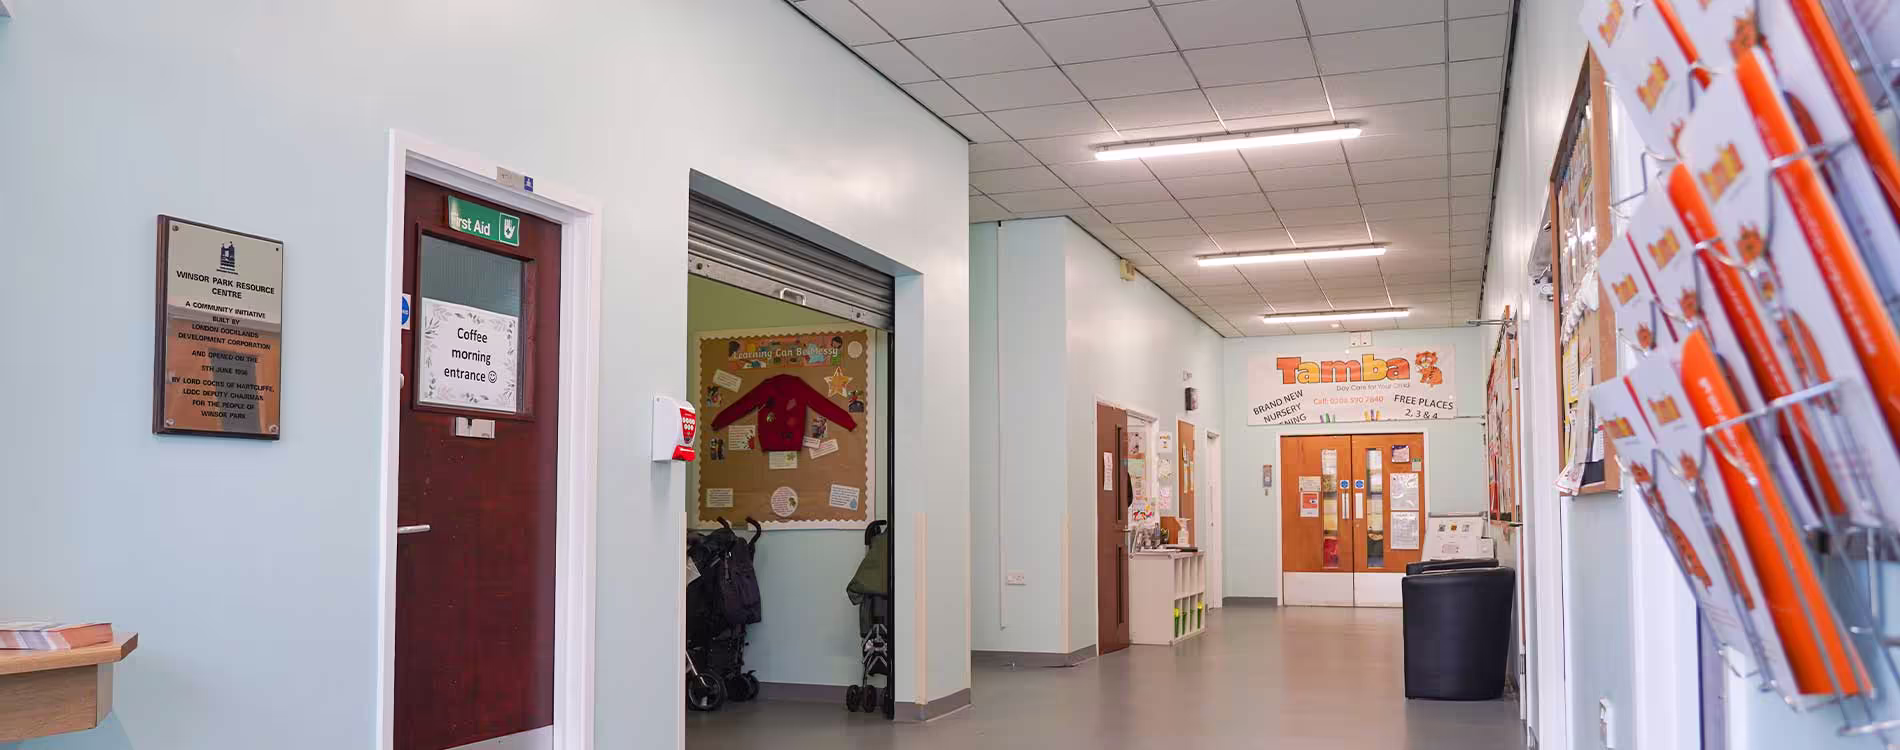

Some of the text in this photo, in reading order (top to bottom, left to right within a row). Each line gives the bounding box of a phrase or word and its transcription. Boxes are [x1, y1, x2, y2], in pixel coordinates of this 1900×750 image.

[474, 220, 491, 237] Aid
[176, 270, 210, 284] WINSOR
[212, 277, 234, 288] PARK
[236, 281, 275, 295] RESOURCE
[211, 287, 242, 299] CENTRE
[192, 302, 234, 313] COMMUNITY
[235, 309, 266, 319] INITIATIVE
[192, 323, 259, 338] LONDON DOCKLANDS
[457, 327, 488, 343] Coffee
[178, 332, 271, 350] DEVELOPMENT CORPORATION
[208, 351, 234, 360] OPENED
[452, 349, 491, 366] morning
[733, 350, 772, 360] Learning
[775, 348, 793, 357] Can
[216, 367, 233, 375] JUNE
[444, 368, 486, 382] entrance
[1276, 353, 1410, 385] Tamba
[202, 390, 228, 398] DEPUTY
[1253, 389, 1303, 415] BRAND NEW
[1394, 394, 1454, 410] FREE PLACES
[1263, 402, 1301, 423] NURSERY
[1405, 408, 1413, 417] 2,
[1415, 409, 1421, 418] 3
